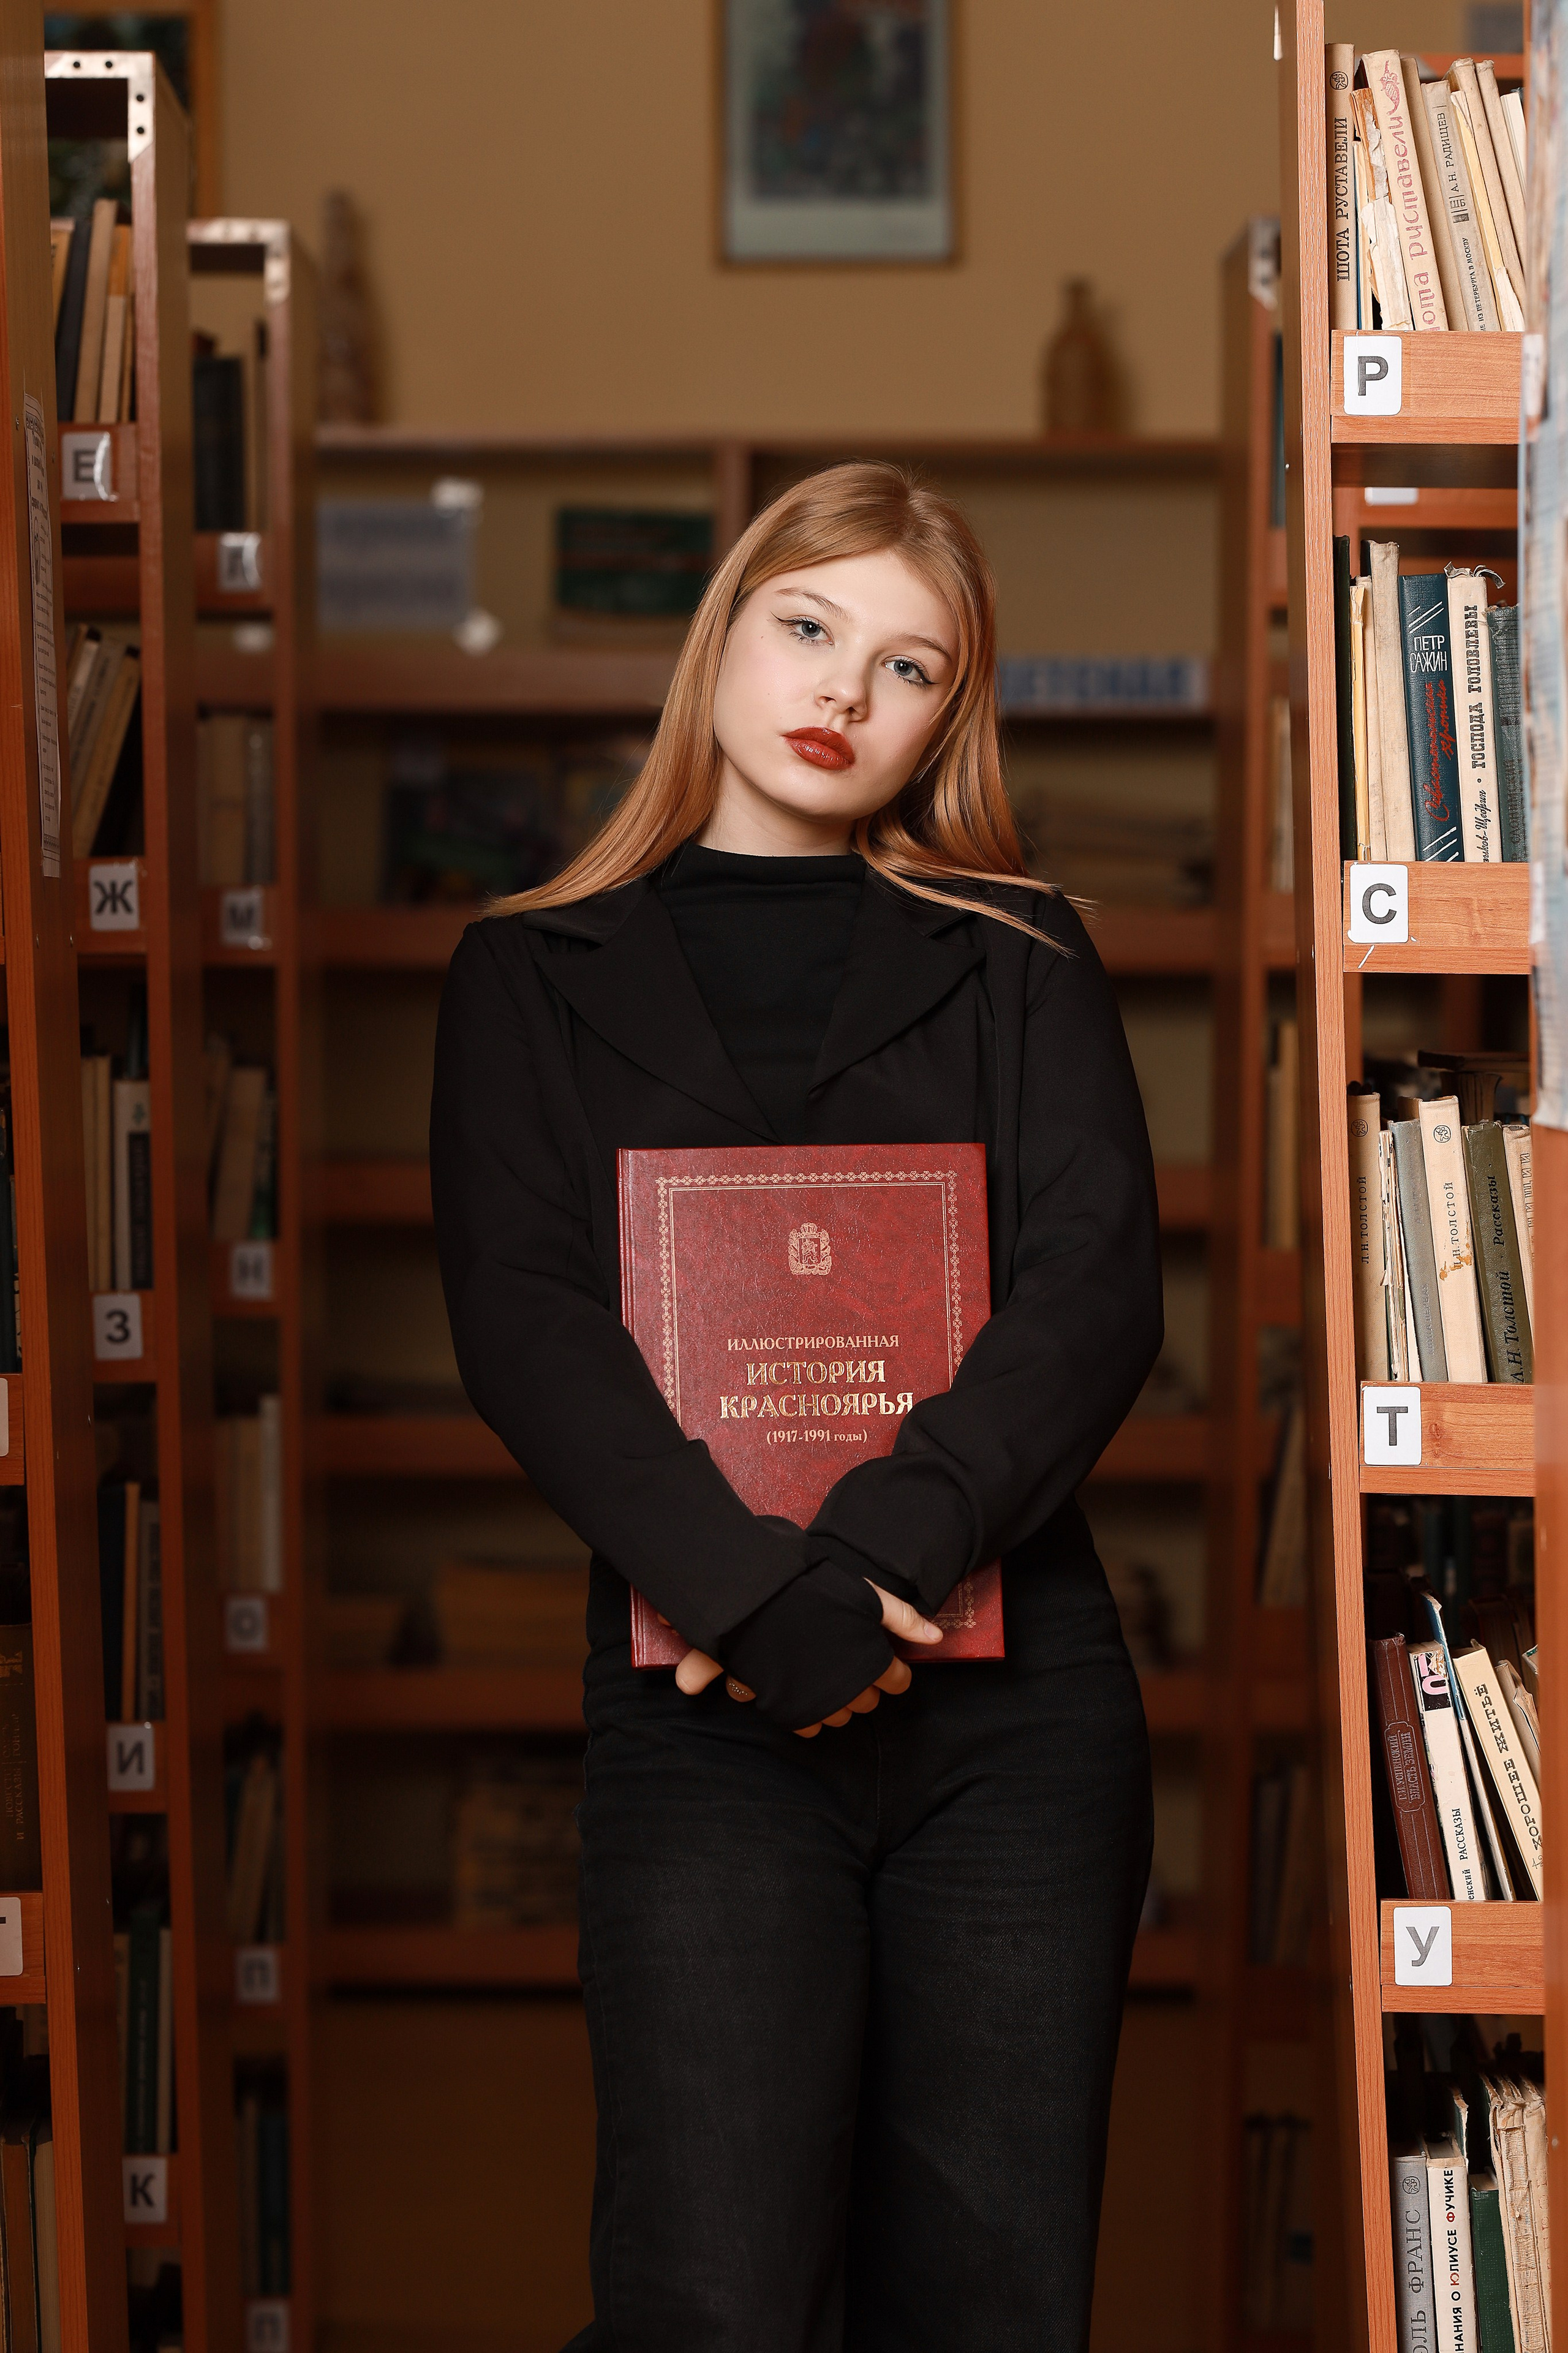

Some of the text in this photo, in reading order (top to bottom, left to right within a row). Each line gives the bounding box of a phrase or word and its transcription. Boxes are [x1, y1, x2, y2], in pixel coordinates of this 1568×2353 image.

[1437, 112, 1455, 168] РАДИЩЕВ
[1334, 117, 1350, 282] ШОТА РУСТАВЕЛИ
[1462, 237, 1473, 264] МОСКВУ
[1471, 274, 1483, 312] ПЕТЕРБУРГА
[1357, 356, 1388, 396] Р
[1410, 651, 1448, 673] САЖИН
[1414, 635, 1444, 651] ПЕТР
[1468, 702, 1486, 769] ГОСПОДА
[94, 880, 134, 915] Ж
[1362, 883, 1397, 924] С
[1487, 1174, 1506, 1247] Рассказы
[727, 1335, 900, 1351] ИЛЛЮСТРИРОВАННАЯ
[746, 1359, 886, 1386] ИСТОРИЯ
[720, 1392, 914, 1419] КРАСНОЯРЬЯ
[766, 1429, 868, 1445] (1917-1991 годы)
[1376, 1406, 1408, 1446] Т
[1474, 1682, 1509, 1754] ЖИТЬЁ
[1452, 1808, 1468, 1860] РАССКАЗЫ
[130, 2173, 156, 2208] К
[1443, 2169, 1456, 2223] ФУЧИКЕ
[1406, 2208, 1425, 2295] ФРАНС
[1447, 2229, 1460, 2286] ЮЛИУСЕ
[1451, 2291, 1461, 2302] О
